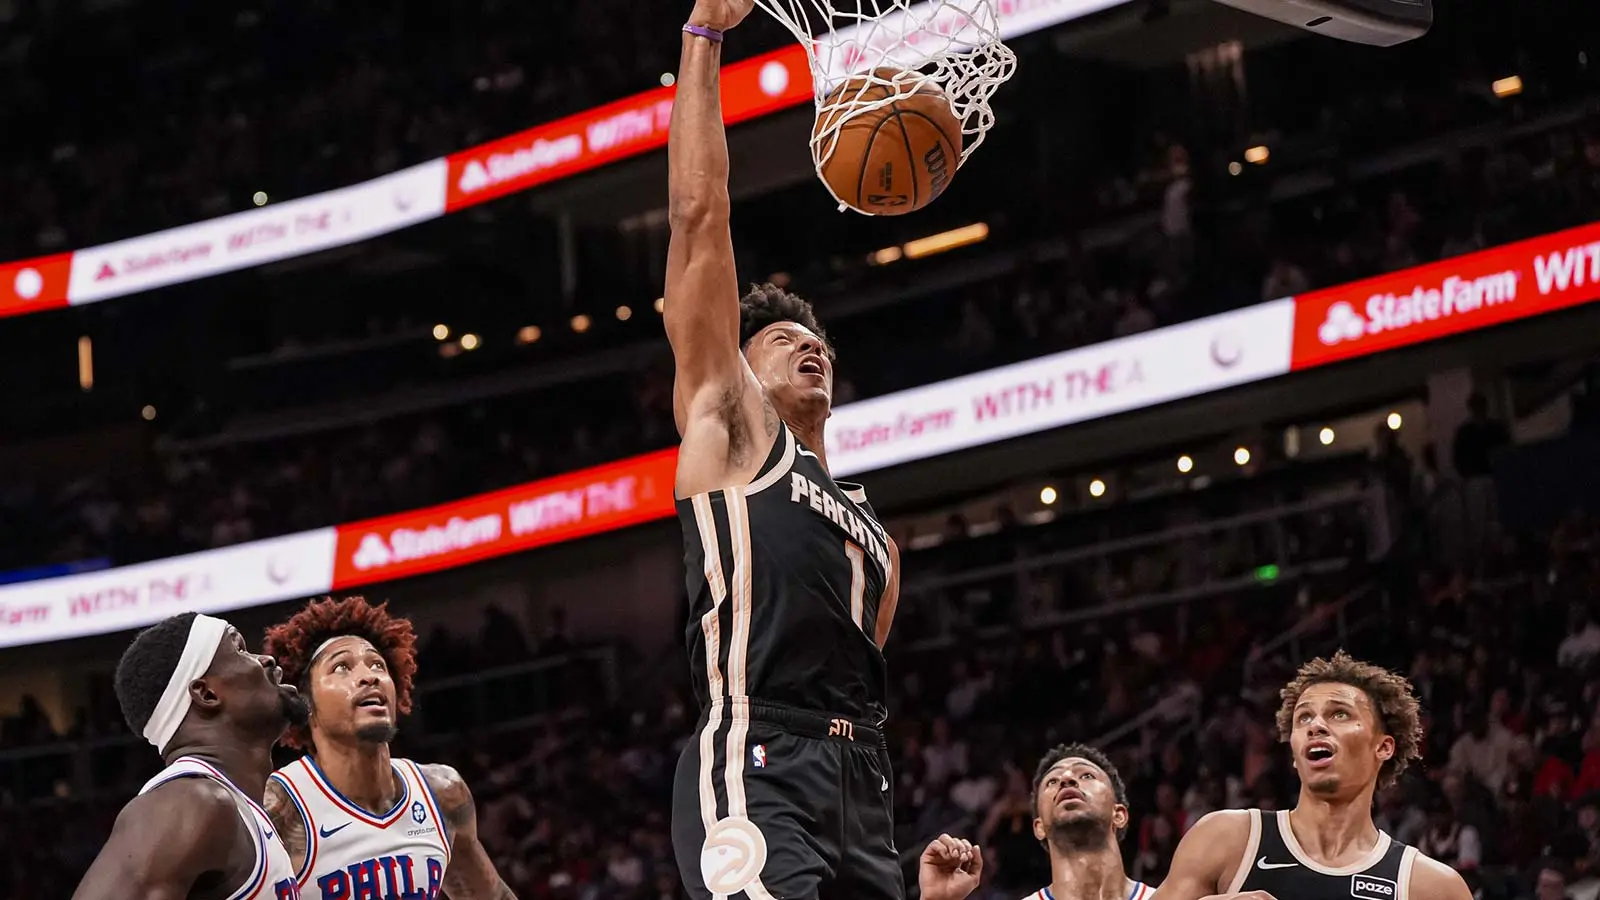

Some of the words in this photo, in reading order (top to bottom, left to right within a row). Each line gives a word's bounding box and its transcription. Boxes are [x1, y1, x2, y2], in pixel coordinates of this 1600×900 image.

[1366, 271, 1517, 334] StateFarm
[972, 378, 1055, 422] WITH
[1064, 360, 1118, 400] THE
[844, 540, 865, 632] 1
[828, 718, 854, 742] ATL
[1355, 880, 1393, 895] paze
